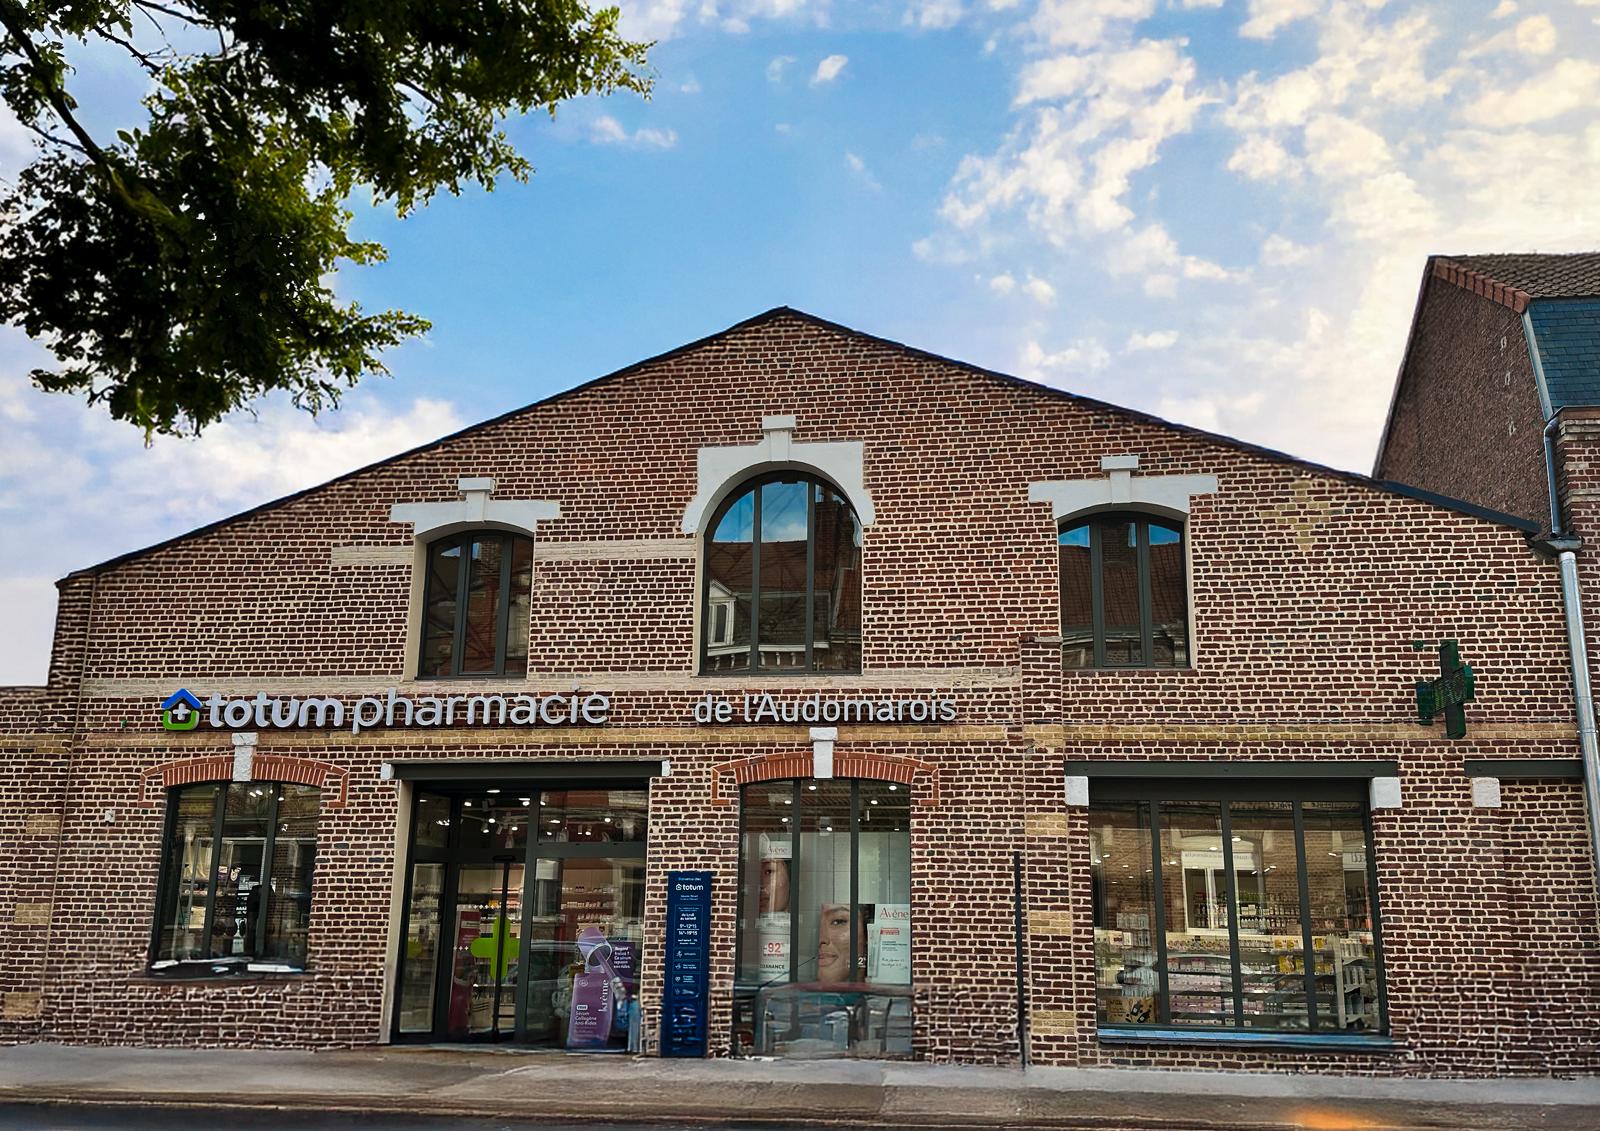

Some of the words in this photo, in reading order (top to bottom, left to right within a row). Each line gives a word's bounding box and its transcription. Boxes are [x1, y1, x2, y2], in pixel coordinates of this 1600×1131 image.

[205, 691, 345, 729] totum
[352, 682, 611, 735] pharmacie
[694, 693, 732, 723] de
[597, 979, 609, 1012] krème
